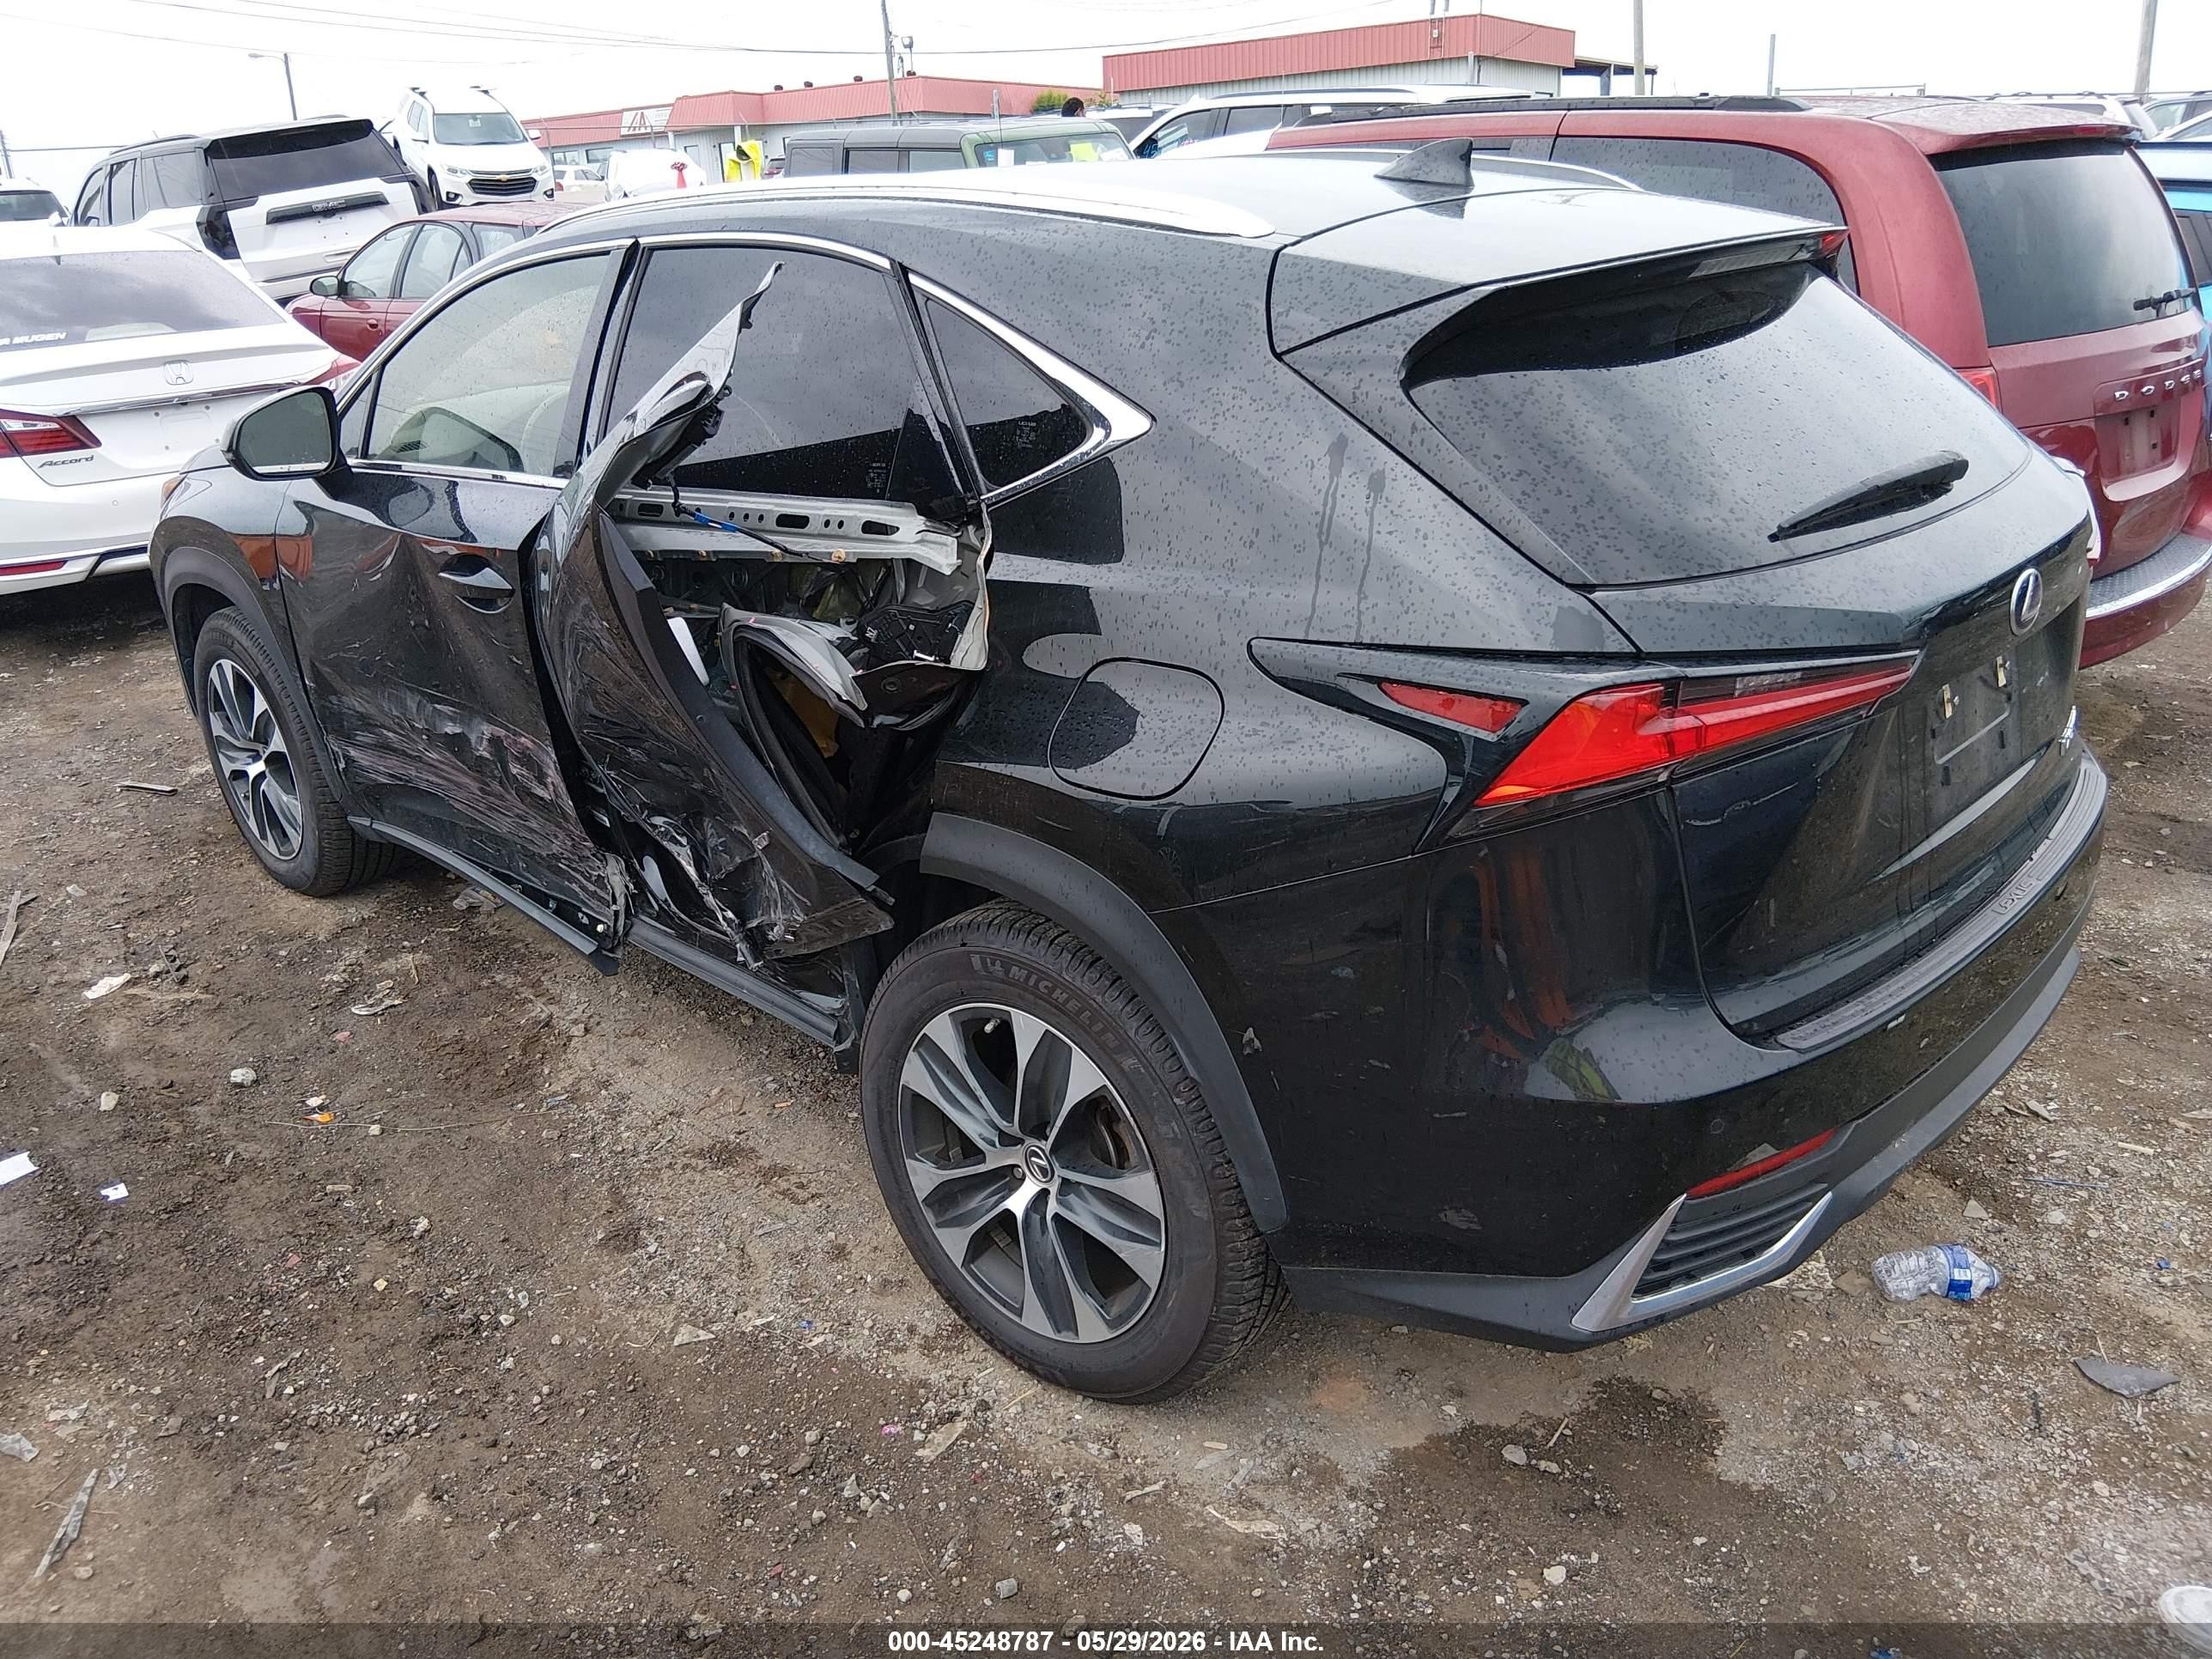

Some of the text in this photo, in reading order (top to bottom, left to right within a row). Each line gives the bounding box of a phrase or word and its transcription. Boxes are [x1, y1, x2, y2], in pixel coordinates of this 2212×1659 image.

[12, 331, 68, 344] MUGEN
[2114, 368, 2202, 401] DODGE
[38, 454, 94, 469] Accord
[1008, 965, 1121, 1048] MICHELIN
